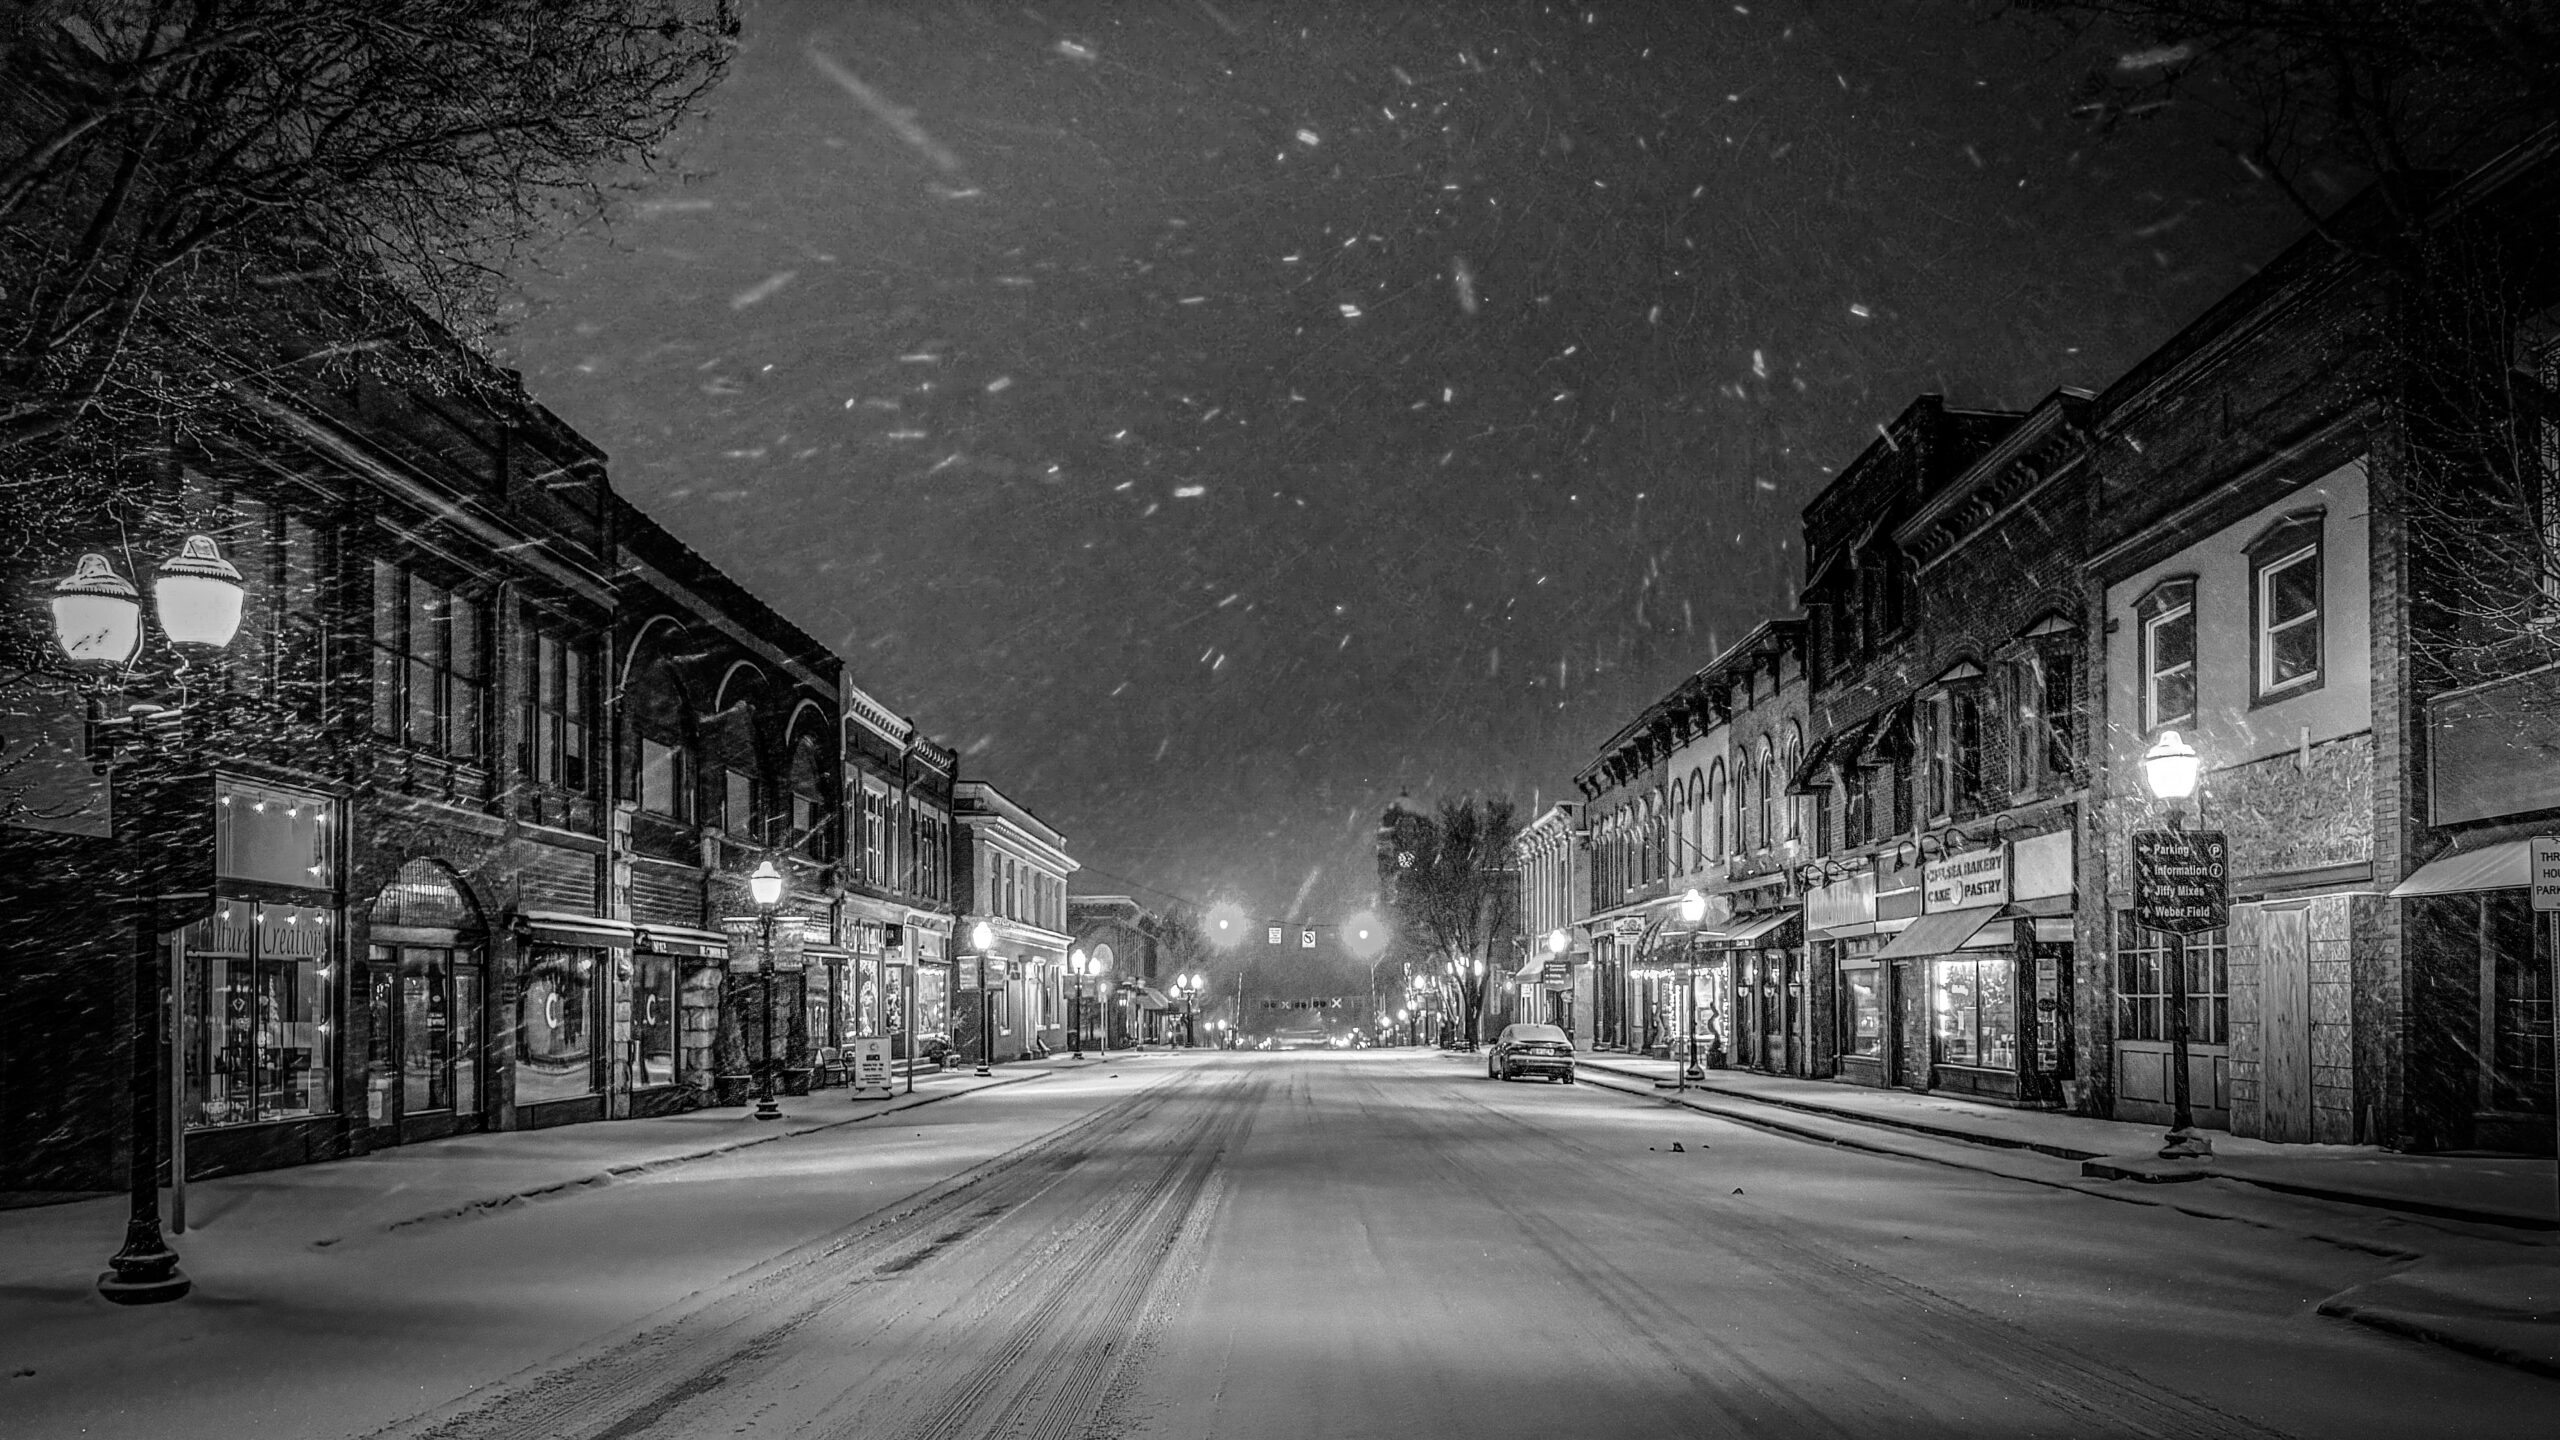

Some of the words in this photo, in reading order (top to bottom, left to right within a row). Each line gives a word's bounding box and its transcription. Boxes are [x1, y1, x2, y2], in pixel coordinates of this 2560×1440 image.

[2153, 843, 2189, 858] Parking
[1926, 864, 1962, 883] CHELSEA
[1963, 855, 2003, 876] BAKERY
[2154, 864, 2208, 876] Information
[1927, 887, 1952, 903] CAKE
[1964, 879, 2002, 898] PASTRY
[2154, 885, 2176, 899] Jiffy
[2177, 885, 2205, 897] Mixes
[2155, 905, 2185, 918] Weber
[2186, 905, 2210, 918] Field
[545, 992, 558, 1029] C
[646, 993, 656, 1026] C
